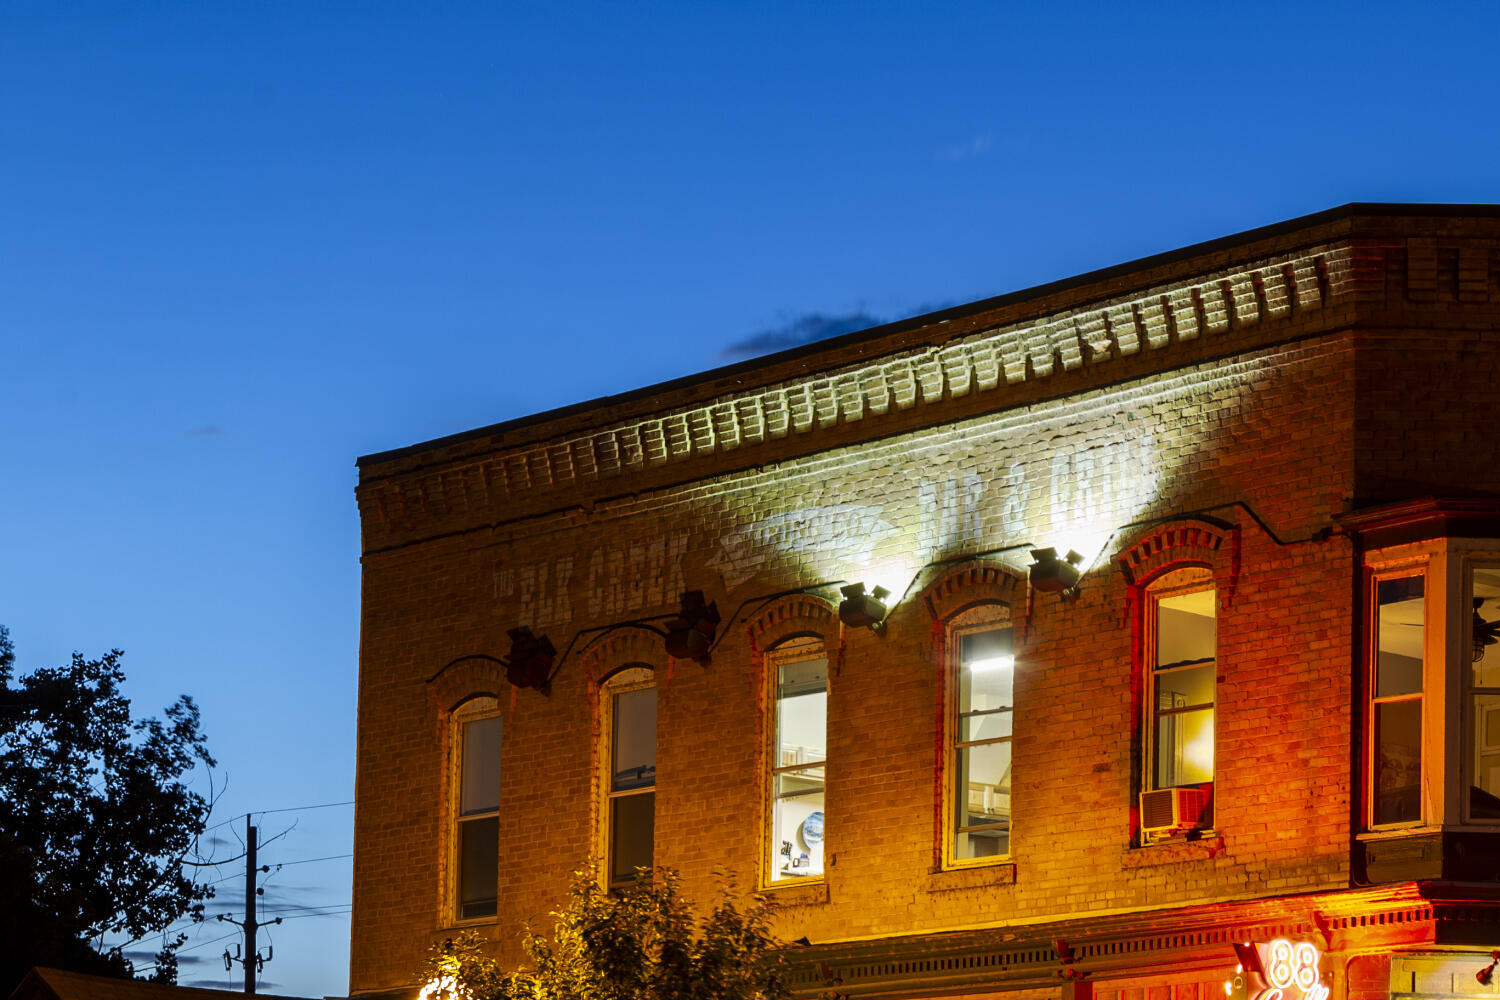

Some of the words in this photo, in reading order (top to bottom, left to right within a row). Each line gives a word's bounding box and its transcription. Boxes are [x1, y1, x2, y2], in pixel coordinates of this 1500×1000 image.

[518, 555, 573, 630] ELK
[586, 534, 689, 618] CREEK
[1269, 938, 1320, 992] 88
